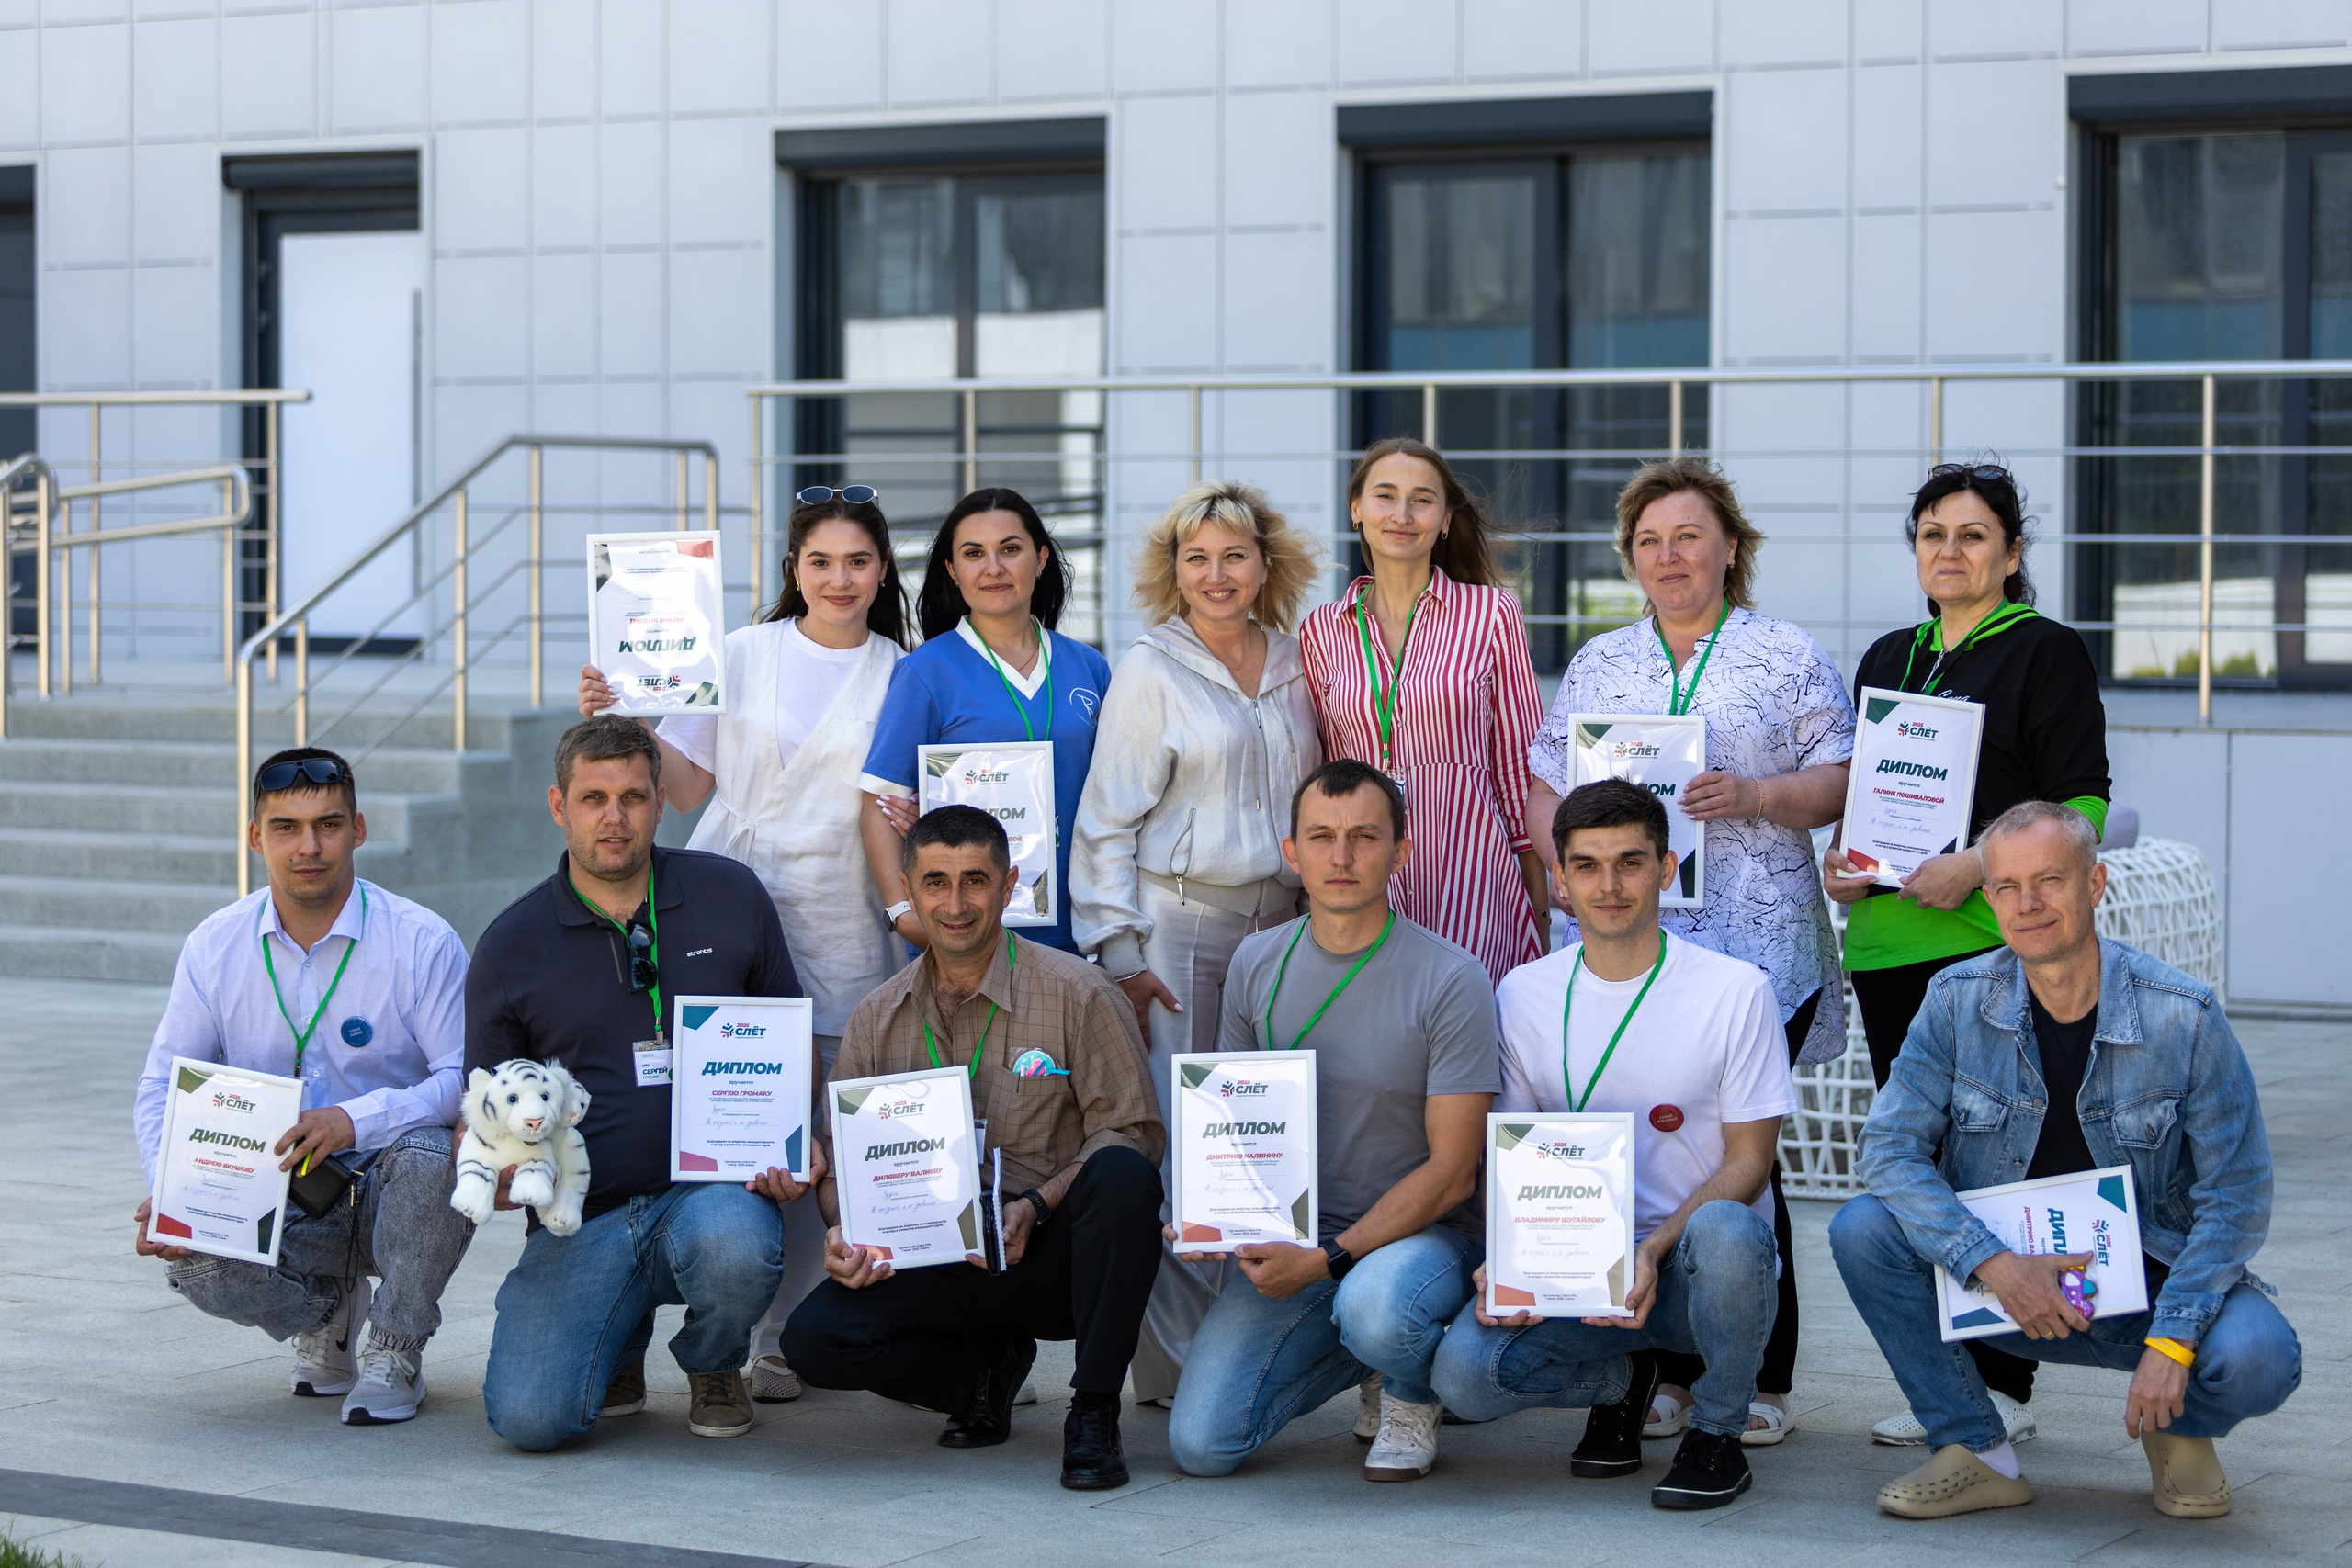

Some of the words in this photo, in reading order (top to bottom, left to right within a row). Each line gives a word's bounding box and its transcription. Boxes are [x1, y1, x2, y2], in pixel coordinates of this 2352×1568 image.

[619, 637, 696, 653] ДИПЛОМ
[637, 679, 667, 688] СЛЁТ
[1910, 727, 1939, 739] СЛЁТ
[1629, 745, 1659, 755] СЛЁТ
[978, 772, 1009, 782] СЛЁТ
[1876, 759, 1948, 781] ДИПЛОМ
[1873, 788, 1896, 796] ГАЛИНЕ
[1896, 791, 1944, 804] ПОШИВАЛОВОЙ
[686, 948, 712, 957] strobbs
[735, 1026, 766, 1036] СЛЁТ
[643, 1066, 667, 1075] СЕРГЕЙ
[702, 1062, 782, 1076] ДИПЛОМ
[1236, 1083, 1268, 1093] СЛЁТ
[226, 1100, 256, 1111] СЛЁТ
[893, 1102, 924, 1114] СЛЁТ
[1203, 1122, 1286, 1138] ДИПЛОМ
[189, 1128, 266, 1152] ДИПЛОМ
[865, 1137, 945, 1161] ДИПЛОМ
[1552, 1145, 1585, 1156] СЛЁТ
[194, 1157, 221, 1168] АНДРЕЮ
[223, 1163, 254, 1173] ЯКУШОВУ
[873, 1172, 910, 1182] ДИЛЯВЕРУ
[910, 1168, 943, 1177] ВАЛИЕВУ
[1517, 1186, 1602, 1201] ДИПЛОМ
[2024, 1207, 2034, 1243] ДМИТРИЮ
[2047, 1208, 2067, 1254] ДИПЛ
[2096, 1234, 2110, 1266] СЛЁТ
